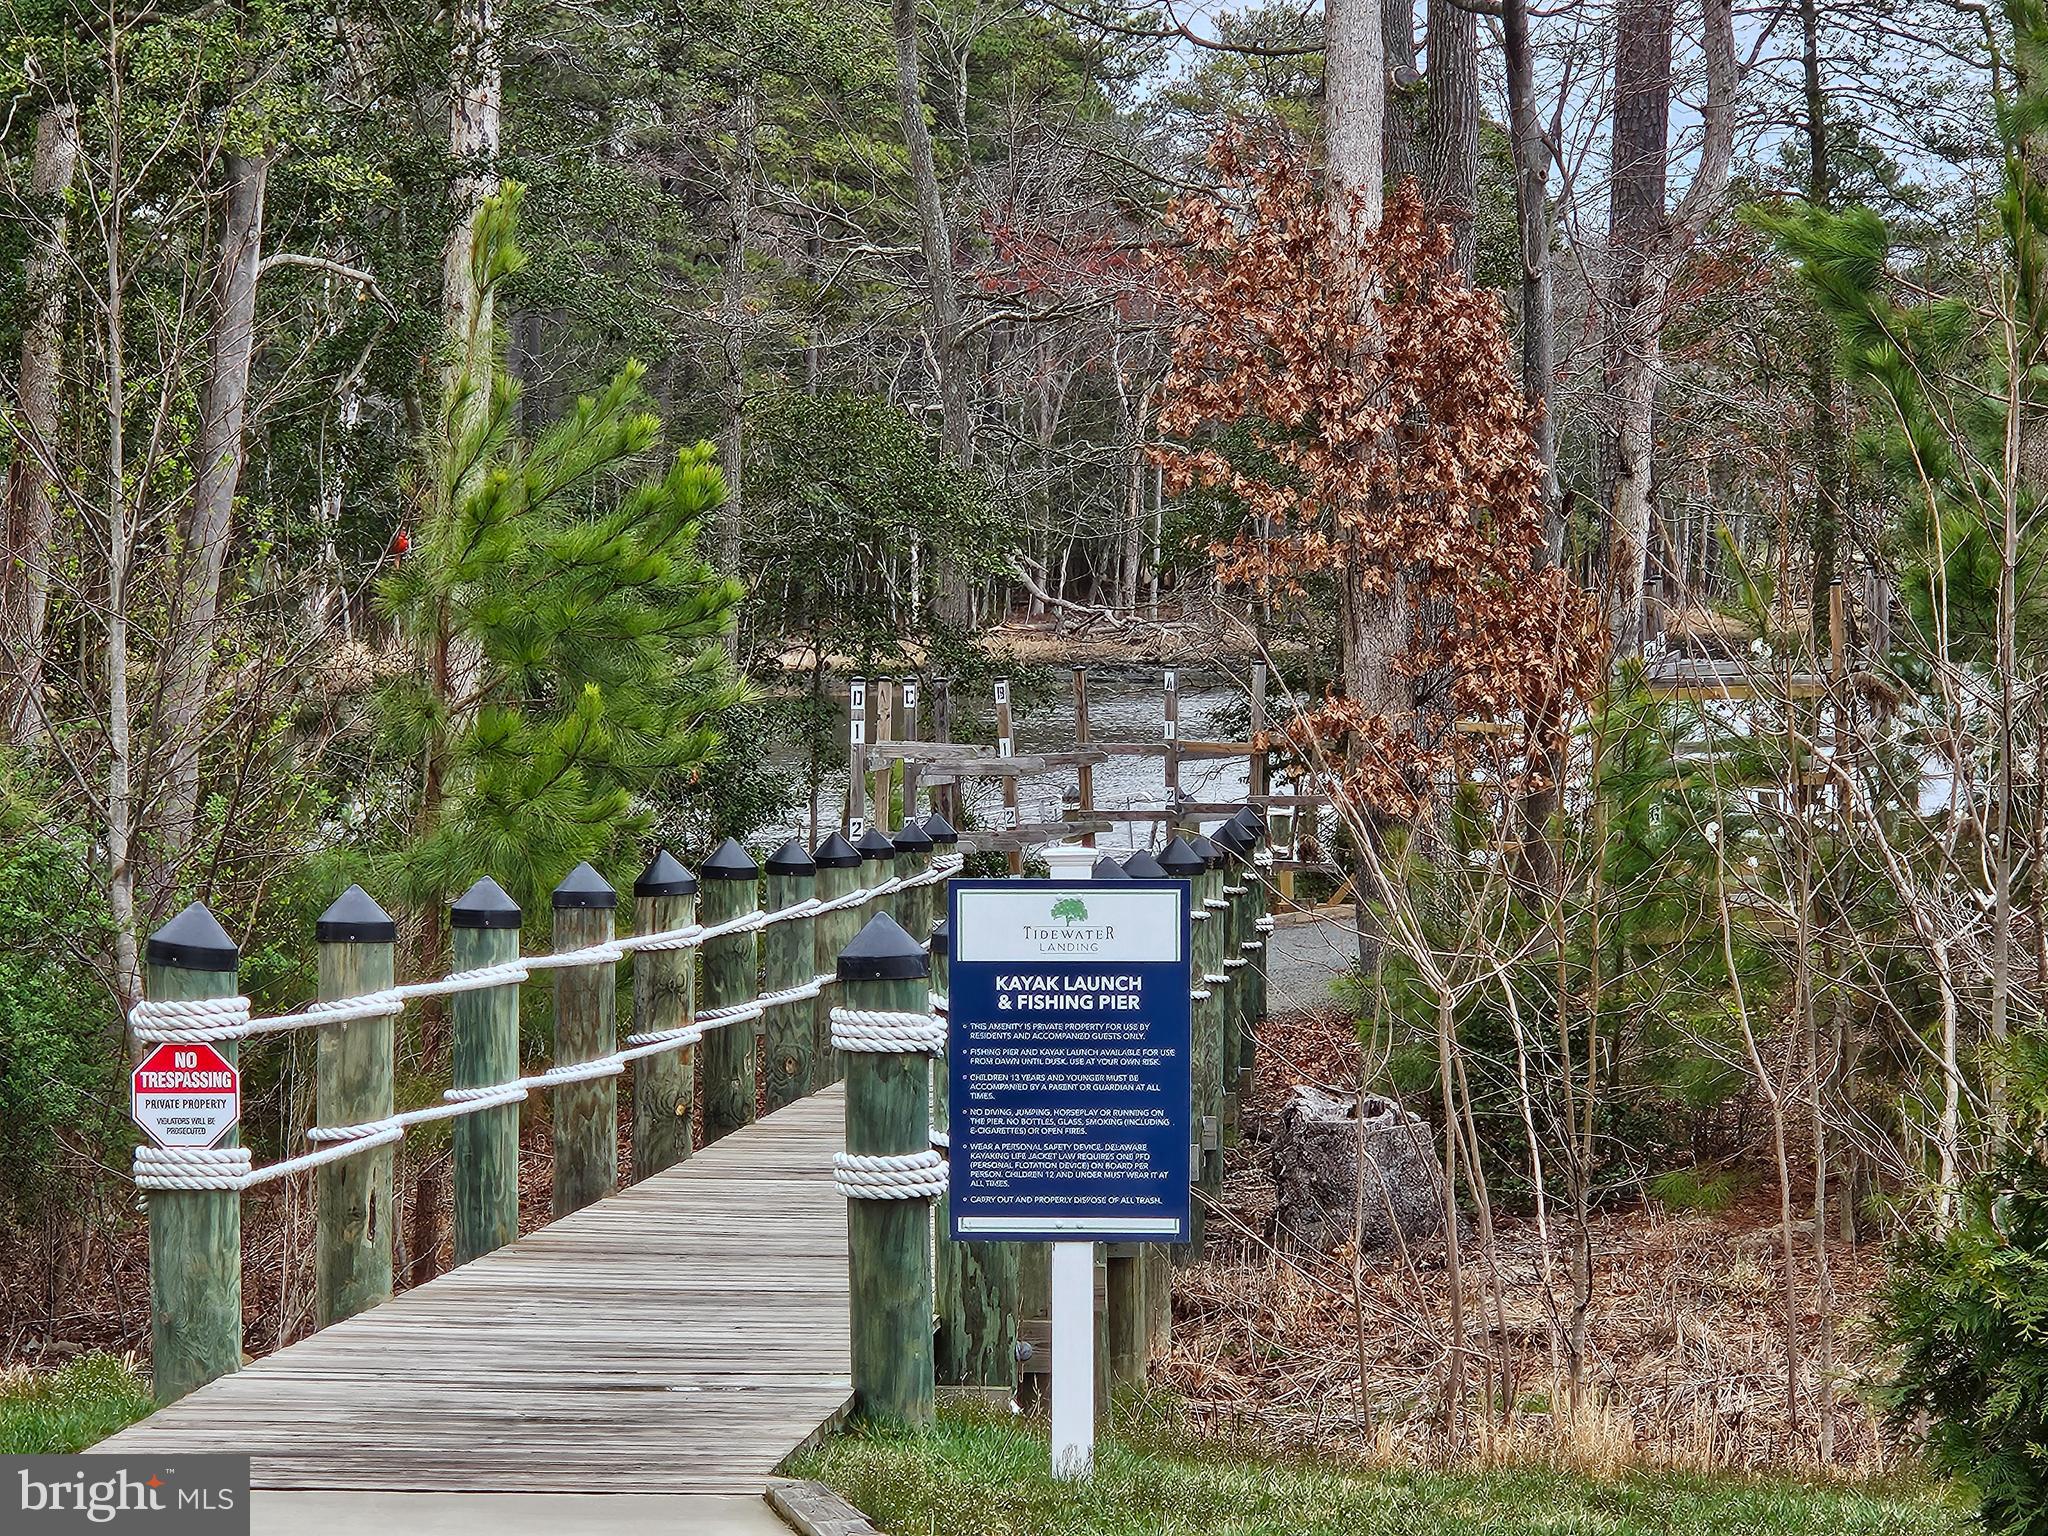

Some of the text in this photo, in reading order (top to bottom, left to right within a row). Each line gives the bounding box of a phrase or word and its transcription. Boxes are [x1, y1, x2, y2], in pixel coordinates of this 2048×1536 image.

[905, 690, 915, 704] C
[997, 686, 1006, 700] B
[853, 692, 863, 706] D
[1006, 811, 1015, 824] 2
[852, 821, 862, 837] 2
[1023, 926, 1115, 940] TIDEWATER
[1039, 943, 1099, 952] LANDING
[995, 976, 1142, 991] KAYAK LAUNCH
[998, 995, 1141, 1010] & FISHING PIER
[175, 1052, 197, 1068] NO
[140, 1071, 232, 1088] TRESPASSING
[145, 1099, 227, 1109] PRIVATE PROPERTY
[970, 1108, 983, 1116] NO
[1053, 1108, 1099, 1116] HORSEPLAY
[1099, 1109, 1112, 1117] OR
[1112, 1109, 1150, 1117] RUNNING
[1150, 1109, 1164, 1117] ON
[157, 1117, 215, 1125] VIOLATORS WILL BE
[166, 1127, 206, 1135] PROSECUTED
[969, 1143, 994, 1151] WEAR
[994, 1143, 1001, 1151] A
[1001, 1143, 1042, 1151] PERSONAL
[1043, 1143, 1073, 1151] SAFETY
[1104, 1143, 1149, 1151] DELAWARE
[970, 1152, 1151, 1161] KAYAKING LIFE JACKET LAW REQUIRES ONE PFD
[1014, 1161, 1058, 1169] FLOTATION
[1090, 1161, 1104, 1169] ON
[1104, 1161, 1134, 1169] BOARD
[1134, 1162, 1149, 1170] PER
[1004, 1170, 1044, 1178] CHILDREN
[1045, 1170, 1056, 1178] 12
[1056, 1170, 1075, 1178] AND
[1075, 1171, 1104, 1179] UNDER
[1103, 1171, 1126, 1179] MUST
[1126, 1171, 1150, 1179] WEAR
[1150, 1171, 1158, 1179] IT
[1158, 1171, 1169, 1179] AT
[969, 1179, 984, 1187] ALL
[970, 1195, 996, 1203] CARRY
[996, 1195, 1014, 1203] OUT
[1014, 1195, 1033, 1203] AND
[1034, 1195, 1073, 1203] PROPERLY
[1073, 1195, 1107, 1203] DISPOSE
[1107, 1195, 1120, 1203] OF
[1120, 1195, 1135, 1203] ALL
